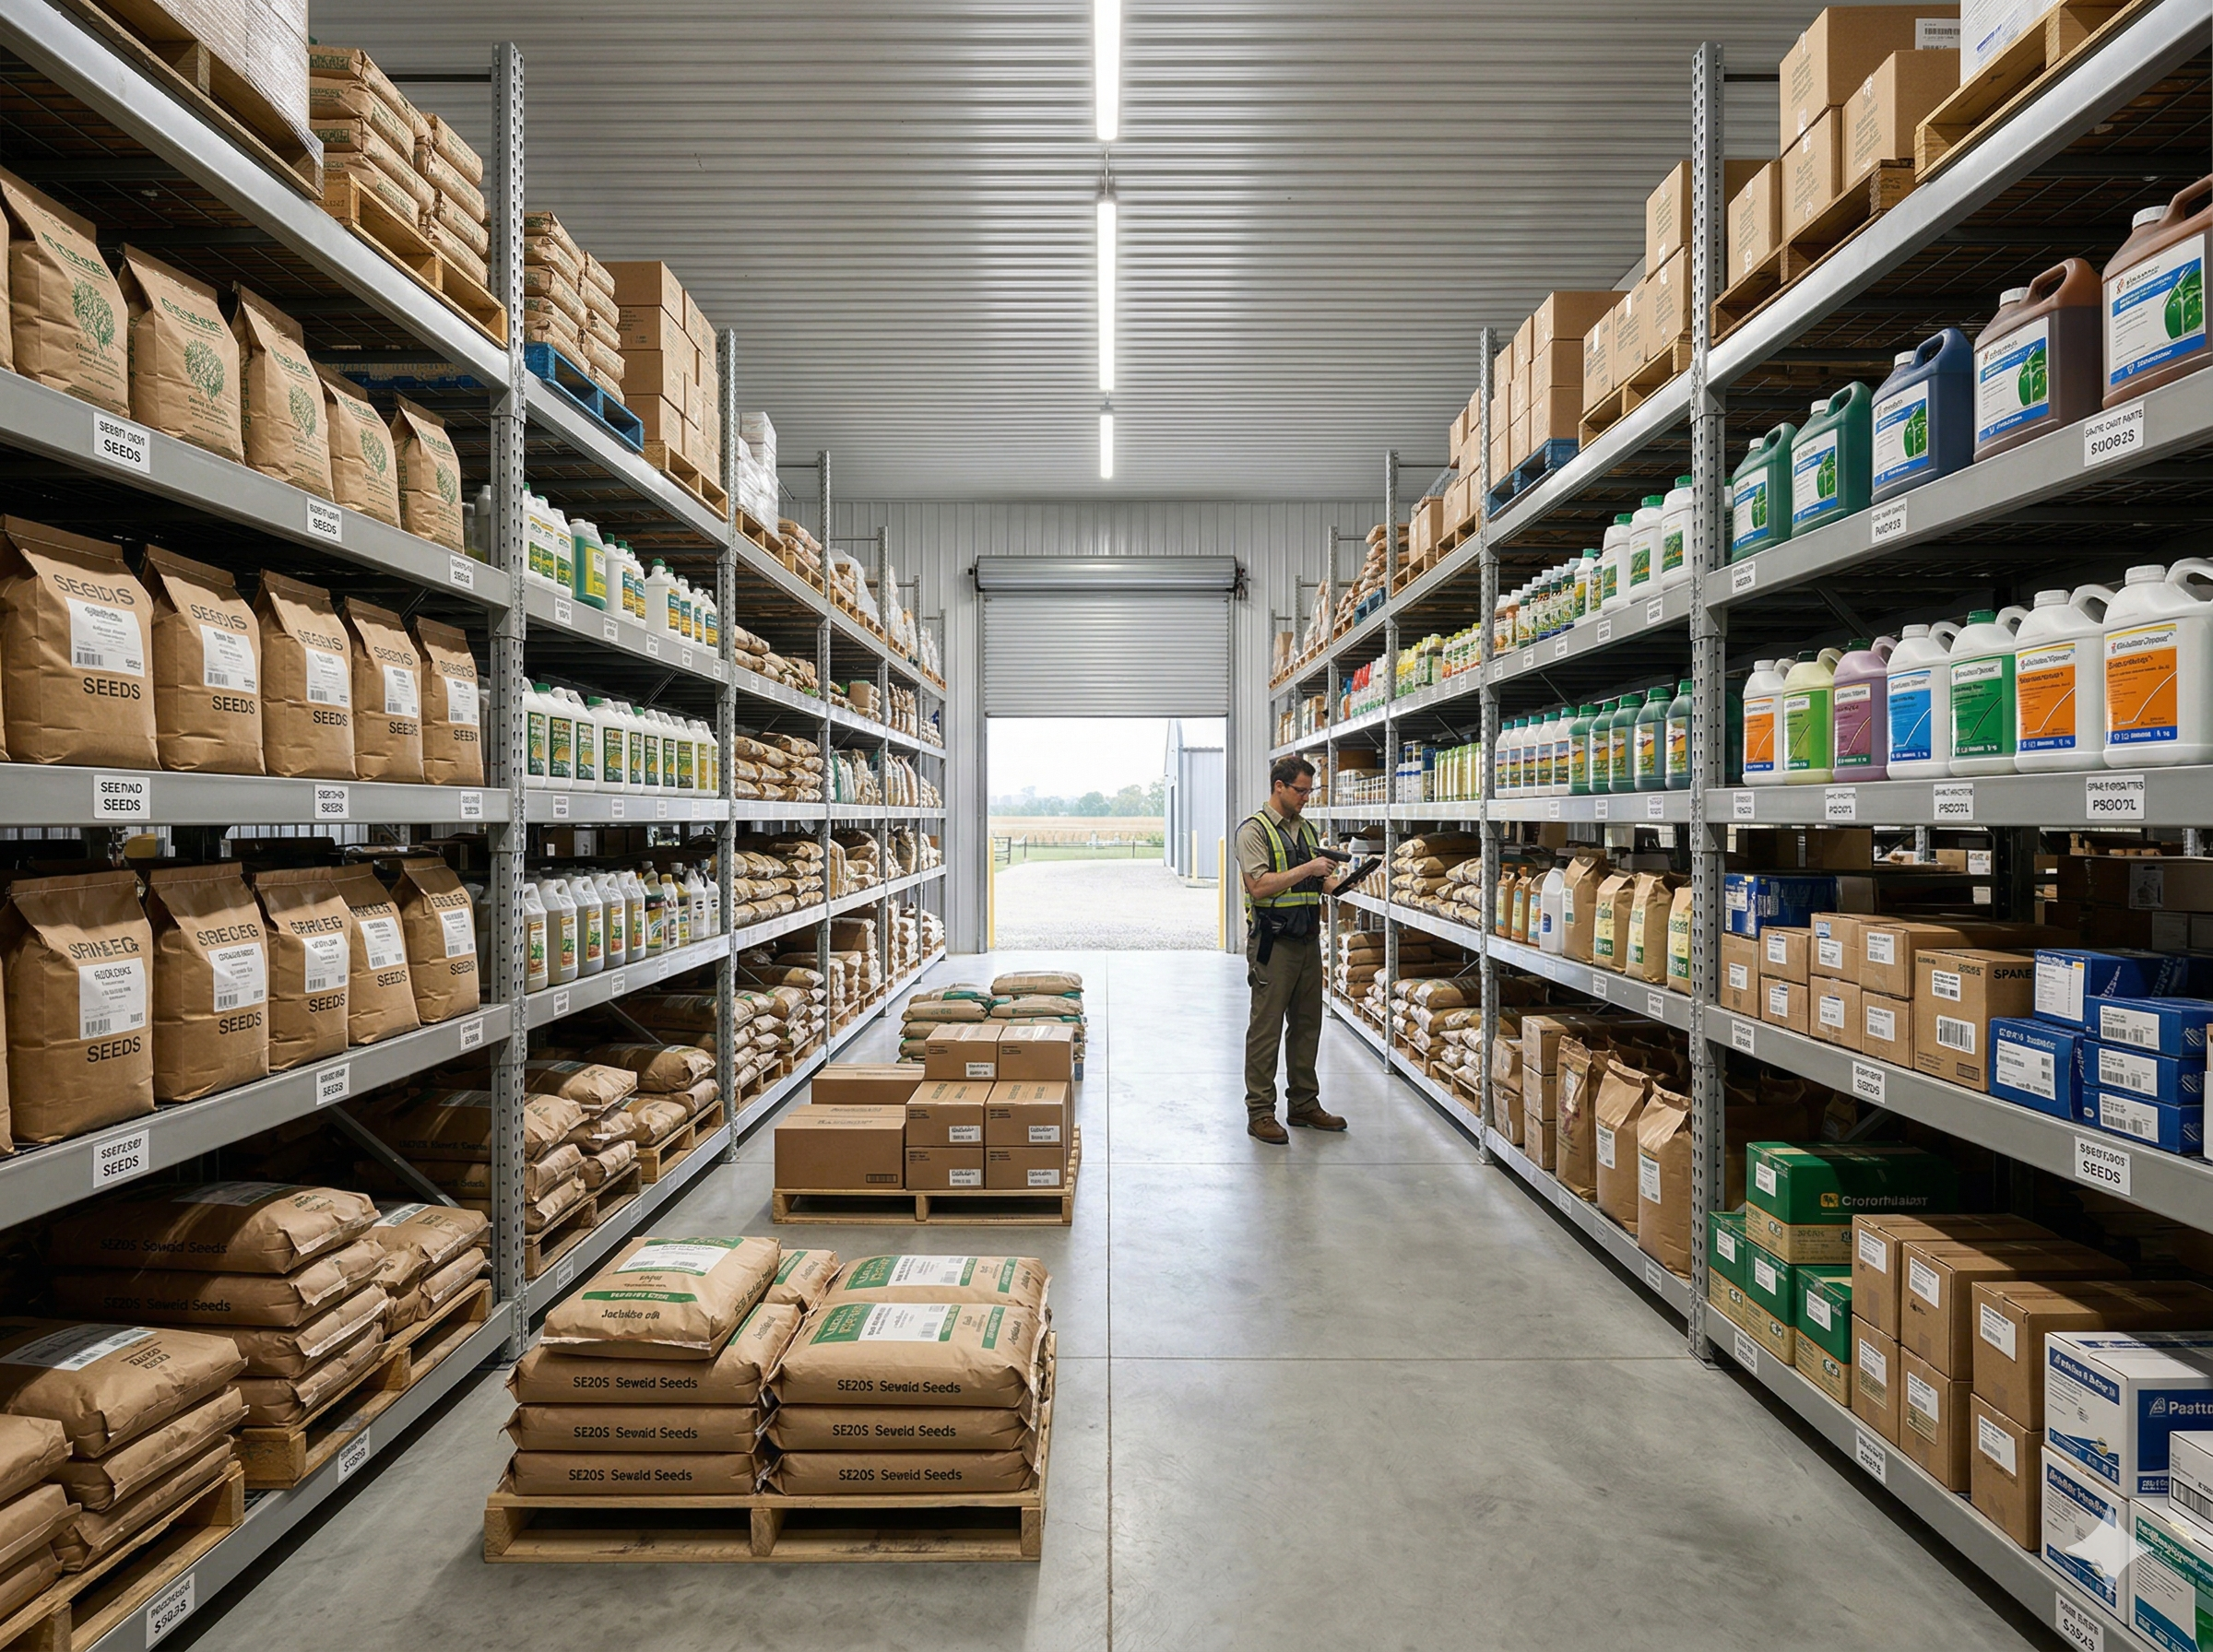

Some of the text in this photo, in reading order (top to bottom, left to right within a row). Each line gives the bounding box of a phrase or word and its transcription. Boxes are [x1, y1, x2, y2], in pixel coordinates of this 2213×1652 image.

[104, 439, 141, 463] SEEDS
[313, 518, 337, 535] SEEDS
[83, 677, 141, 700] SEEDS
[212, 695, 255, 714] SEEDS
[313, 710, 348, 726] SEEDS
[103, 798, 141, 811] SEEDS
[377, 970, 408, 987] SEEDS
[309, 993, 346, 1013] SEEDS
[219, 1011, 262, 1034] SEEDS
[87, 1036, 141, 1063] SEEDS
[103, 1155, 139, 1177] SEEDS
[2083, 1161, 2121, 1184] SEEDS
[188, 1241, 228, 1254] Seeds
[192, 1299, 231, 1312] Seeds
[659, 1376, 698, 1388] Seeds
[923, 1381, 961, 1393] Seeds
[660, 1426, 698, 1439] Seeds
[918, 1424, 956, 1437] Seeds
[654, 1469, 693, 1481] Seeds
[924, 1468, 963, 1481] Seeds
